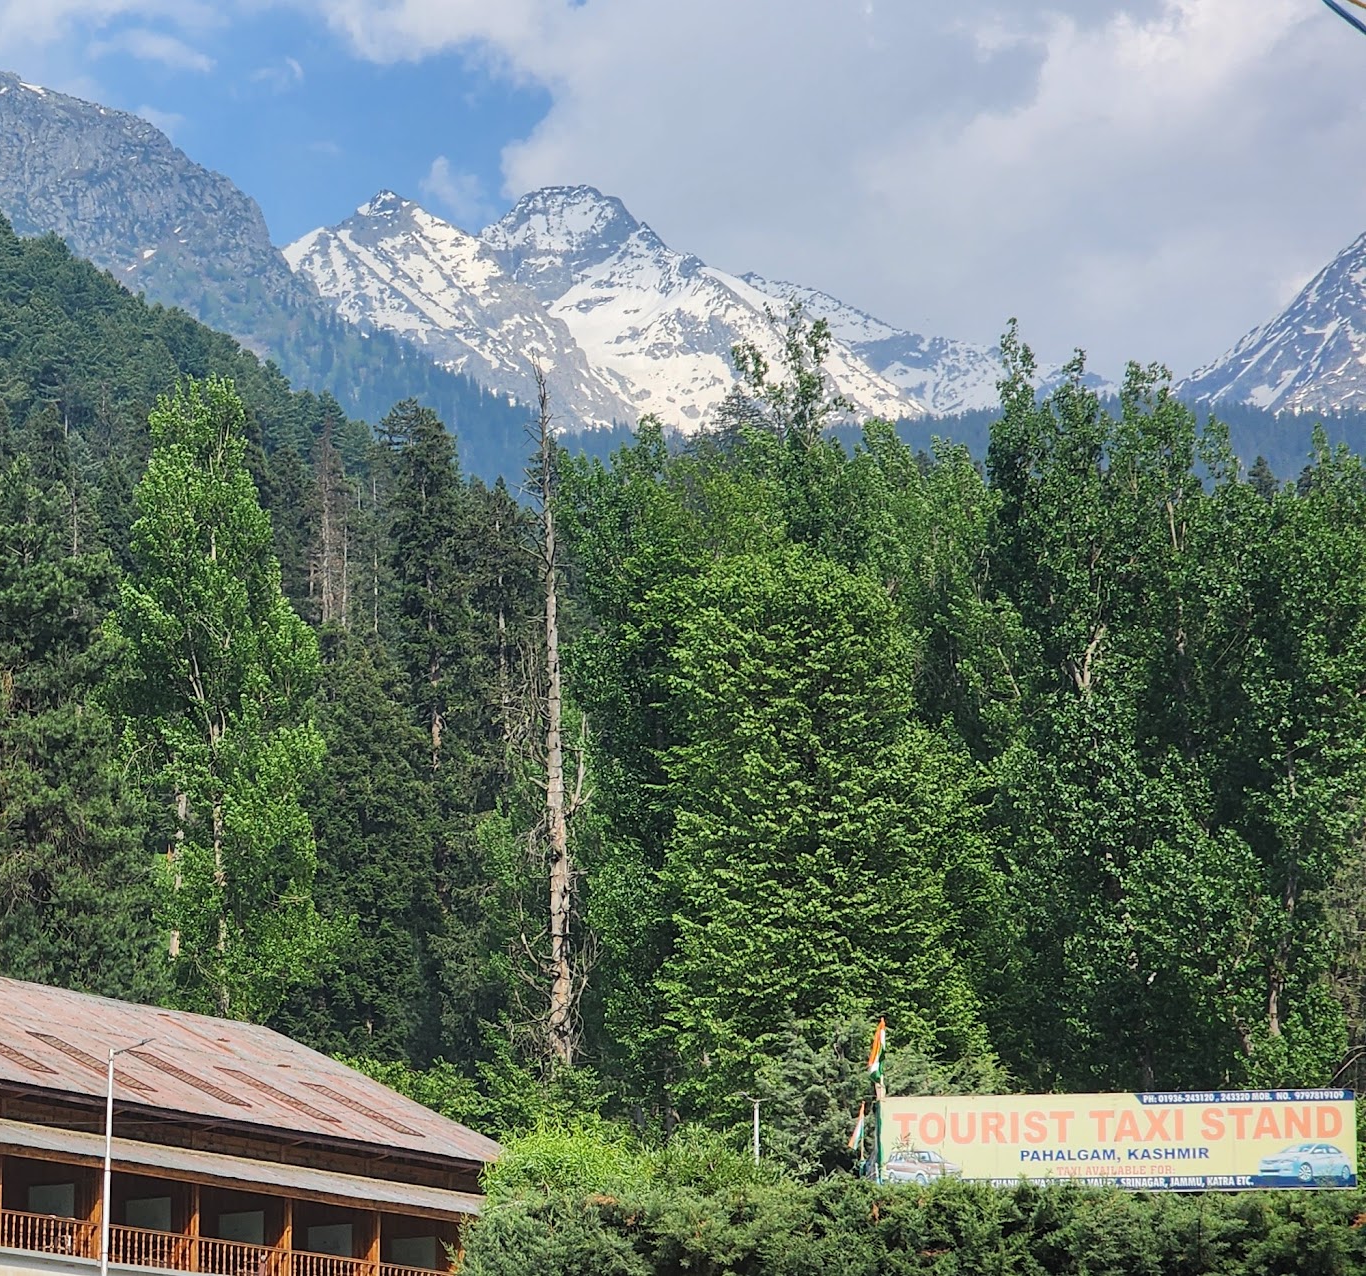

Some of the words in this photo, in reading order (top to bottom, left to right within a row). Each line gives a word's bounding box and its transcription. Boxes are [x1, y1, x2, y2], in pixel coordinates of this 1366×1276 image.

[1142, 1095, 1157, 1103] PH:
[1220, 1093, 1250, 1101] 243320
[1251, 1092, 1273, 1101] MOB.
[1276, 1092, 1291, 1100] NO.
[1294, 1091, 1344, 1100] 9797819109
[892, 1111, 1075, 1145] TOURIST
[1089, 1108, 1184, 1142] TAXI
[1200, 1105, 1343, 1141] STAND
[1020, 1149, 1122, 1163] PAHALGAM,
[1127, 1147, 1210, 1160] KASHMIR
[1056, 1166, 1082, 1176] TAXI
[1084, 1165, 1147, 1176] AVAILABLE
[1150, 1165, 1176, 1175] FOR:
[1120, 1177, 1168, 1188] SRINAGAR,
[1169, 1177, 1205, 1188] JAMMU,
[1206, 1176, 1235, 1187] KATRA
[1236, 1175, 1254, 1186] ETC.
